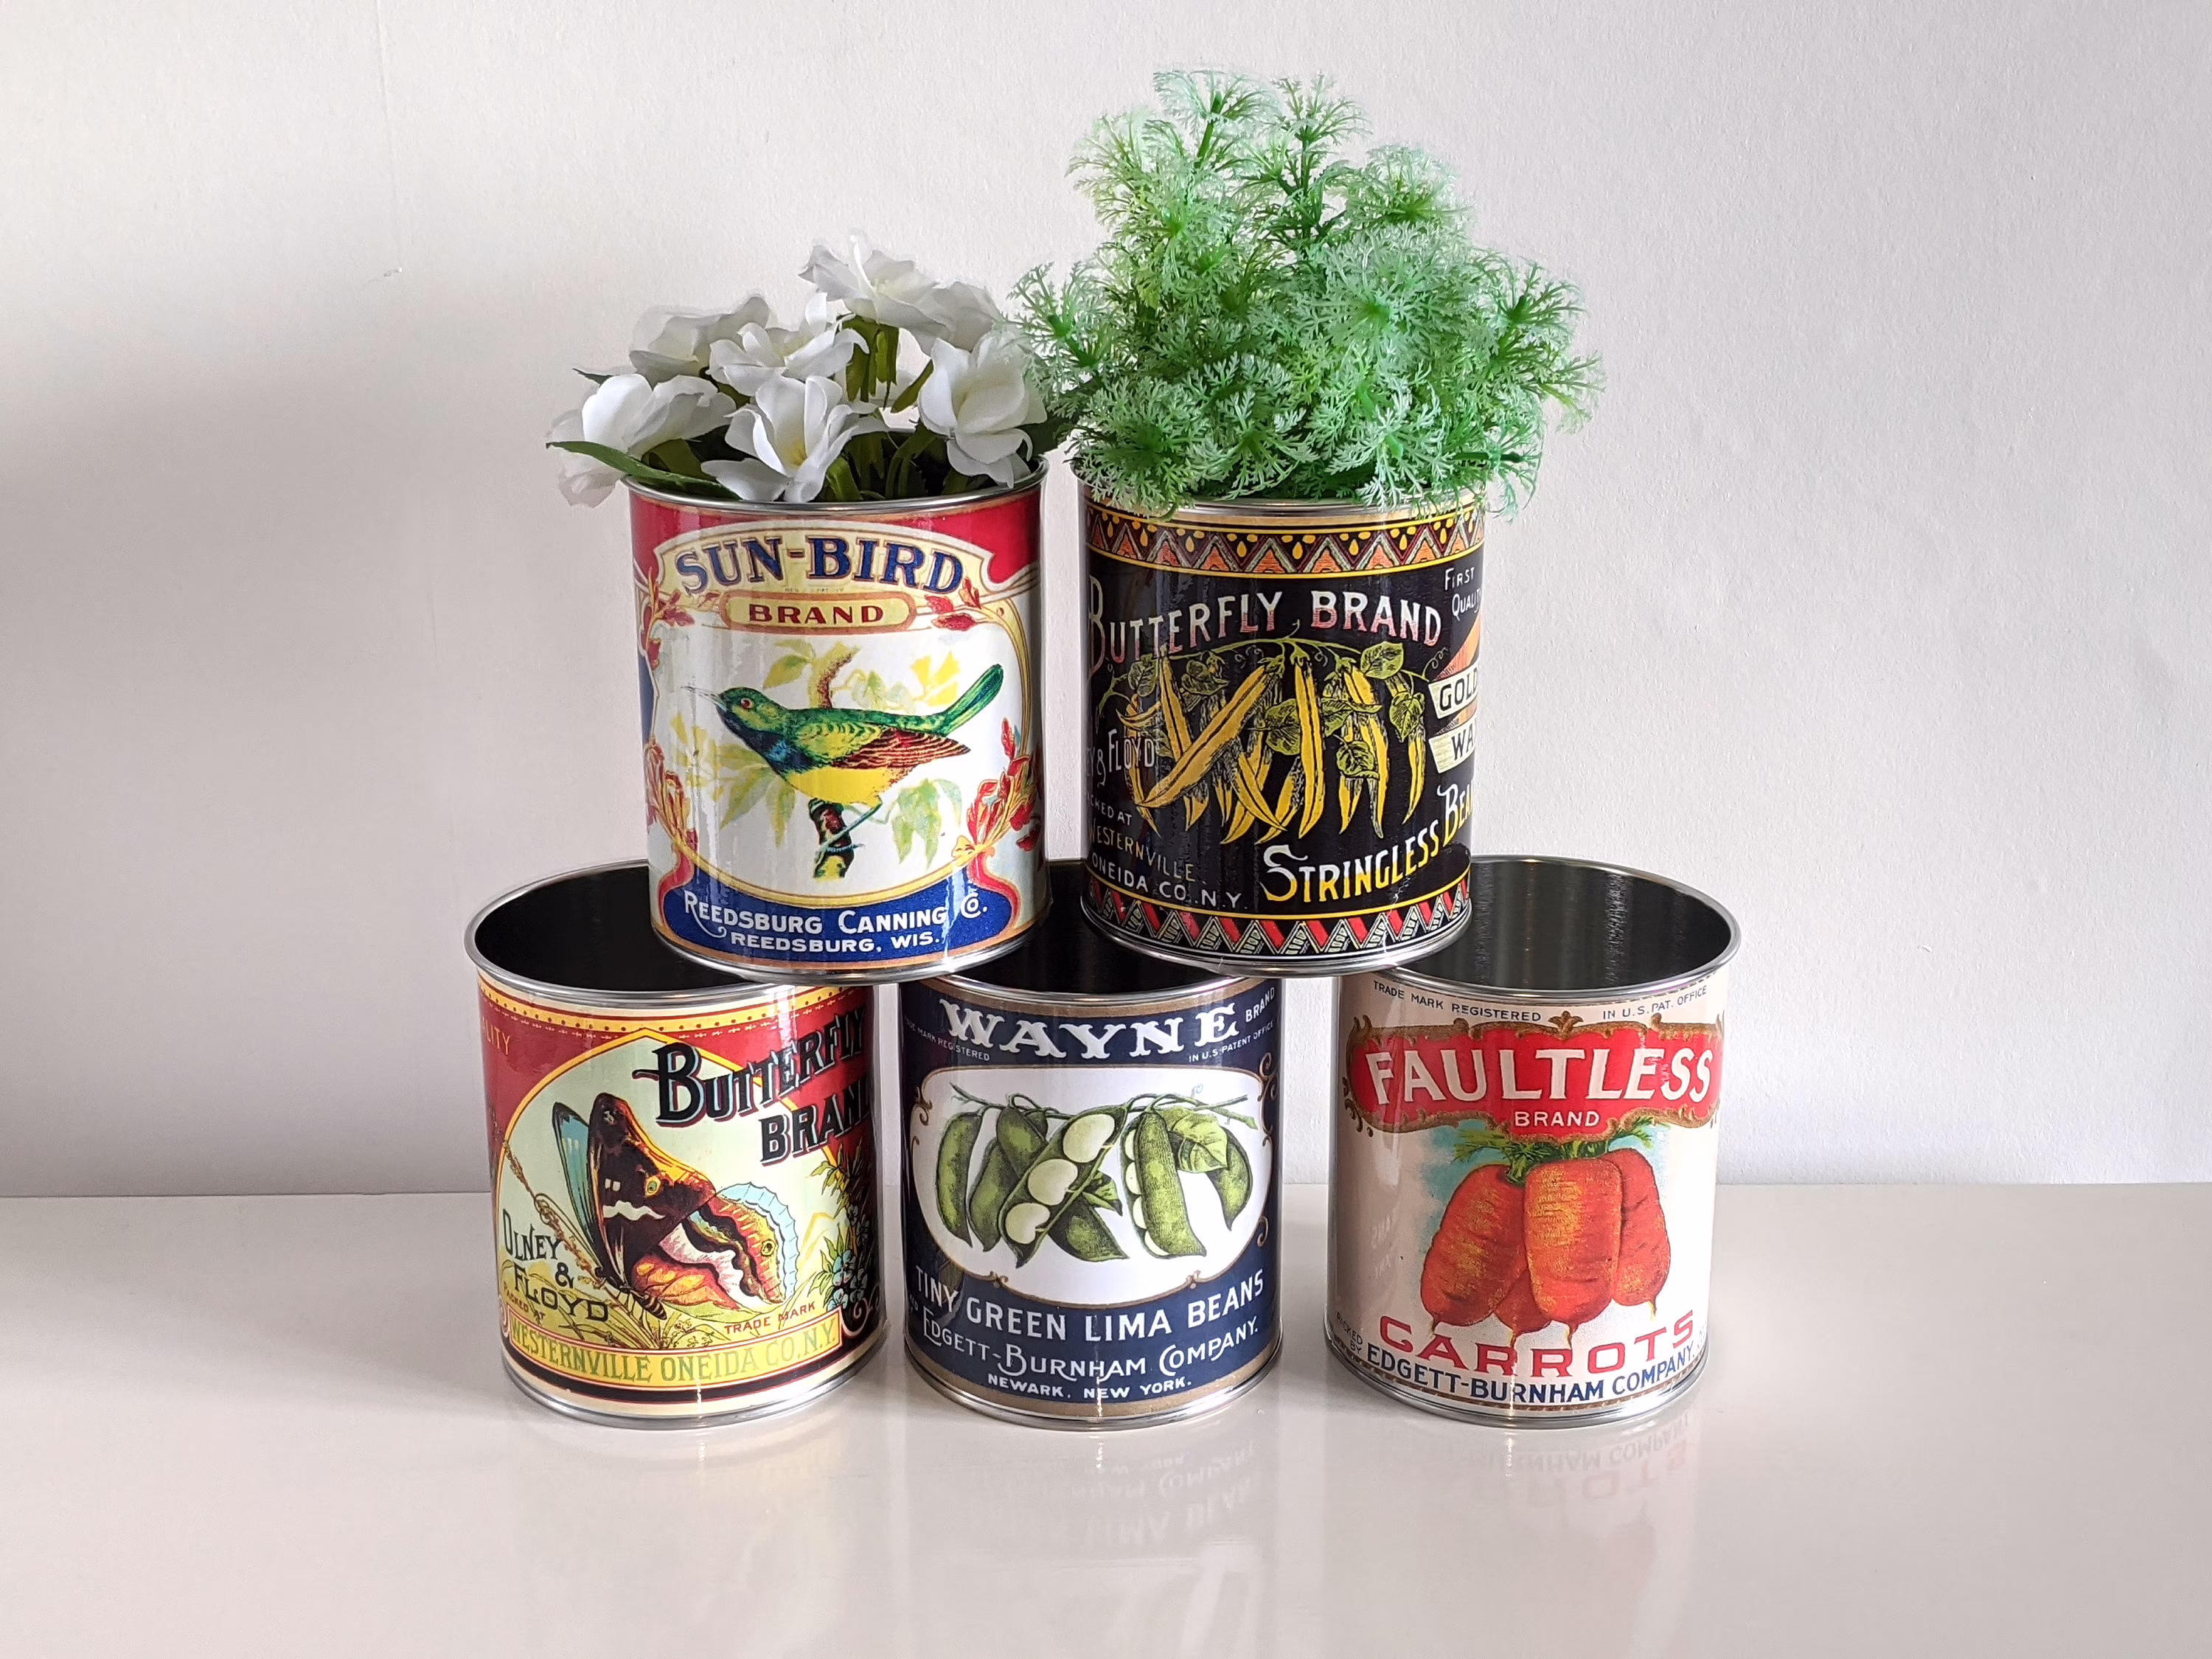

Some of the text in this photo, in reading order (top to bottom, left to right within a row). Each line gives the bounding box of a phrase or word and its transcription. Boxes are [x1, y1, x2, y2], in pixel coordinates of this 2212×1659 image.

[675, 535, 964, 596] SUN-BIRD
[1444, 566, 1475, 590] FIRST
[749, 604, 884, 625] BRAND
[1089, 574, 1441, 678] BUTTERFLY BRAND
[1108, 728, 1155, 773] FLOYD
[1117, 811, 1133, 826] AT
[1092, 852, 1148, 893] ONEIDA
[1260, 820, 1439, 902] STRINGLESS
[684, 890, 822, 939] REEDSBURG
[838, 905, 947, 934] CANNING
[891, 932, 940, 949] WIS.
[939, 987, 1275, 1060] WAYNE BRAND
[1374, 980, 1404, 1000] TRADE
[1411, 993, 1444, 1009] MARK
[1452, 1004, 1541, 1022] REGISTERED
[1603, 1009, 1615, 1020] IN
[1677, 985, 1707, 1005] OFFICE
[632, 1006, 867, 1127] BUTTERFLY
[938, 1037, 990, 1062] REGISTERED
[1366, 1048, 1713, 1106] FAULTLESS
[1514, 1111, 1599, 1127] BRAND
[502, 1208, 563, 1262] OLNEY
[512, 1261, 609, 1322] FLOYD
[554, 1262, 574, 1289] &
[724, 1302, 816, 1335] TRADE MARK
[915, 1265, 959, 1312] TINY
[967, 1296, 1066, 1341] GREEN
[1085, 1309, 1172, 1342] LIMA
[1188, 1269, 1264, 1329] BEANS
[512, 1317, 653, 1383] WESTERNVILLE
[661, 1348, 762, 1382] ONEIDA
[1350, 1340, 1362, 1354] BY
[1380, 1310, 1694, 1378] CARROTS
[1083, 1386, 1130, 1399] NEW
[1367, 1342, 1604, 1403] EDGETT-BURNHAM
